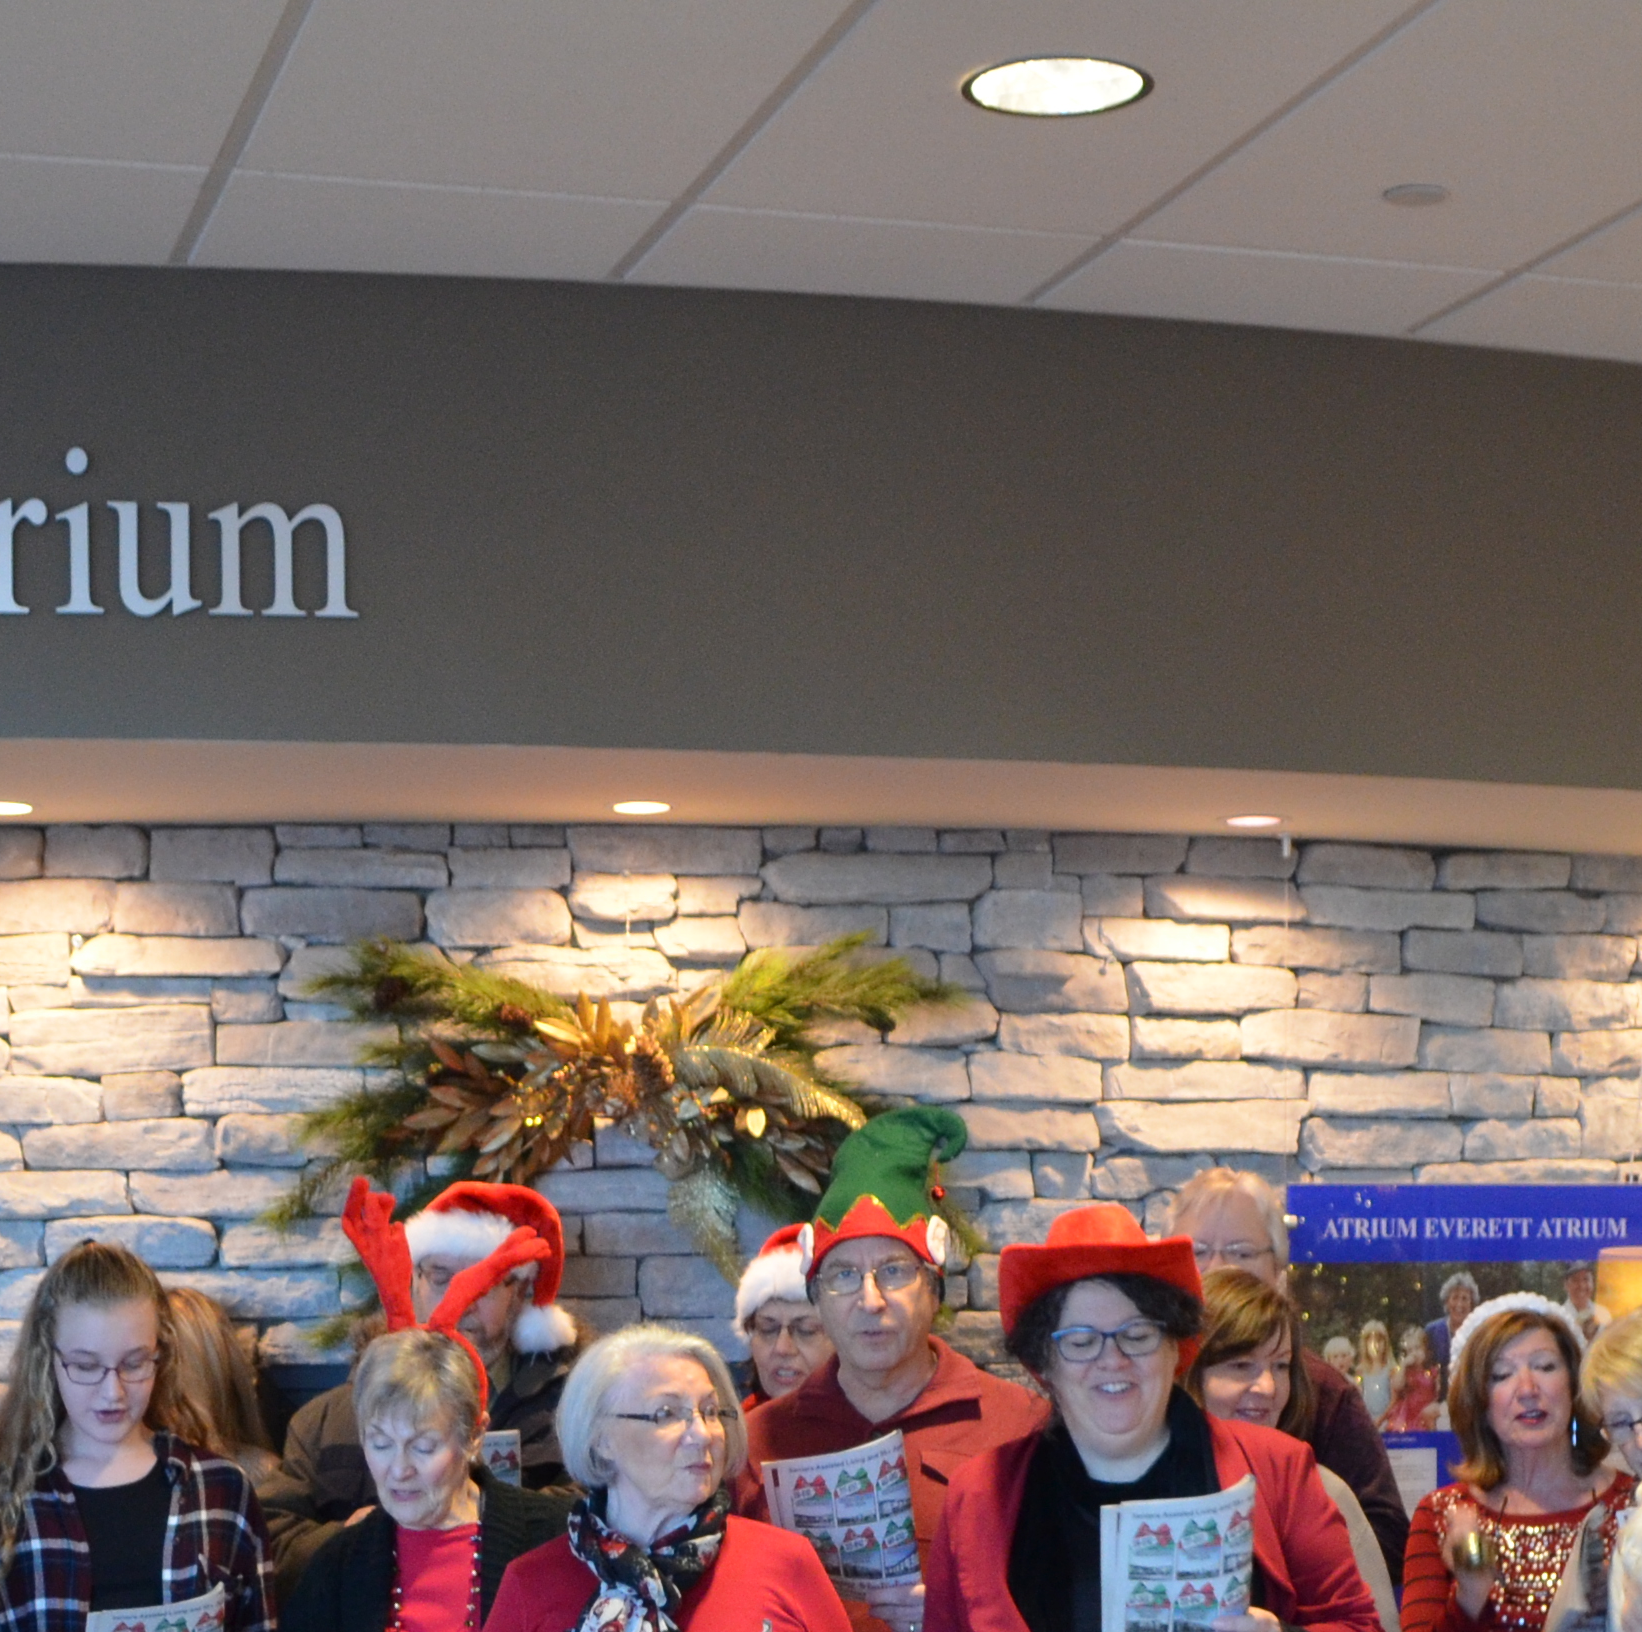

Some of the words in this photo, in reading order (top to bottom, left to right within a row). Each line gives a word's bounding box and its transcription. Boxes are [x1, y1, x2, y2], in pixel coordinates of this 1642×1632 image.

[1323, 1217, 1418, 1239] ATRIUM
[1423, 1217, 1533, 1239] EVERETT
[1536, 1217, 1627, 1239] ATRIUM
